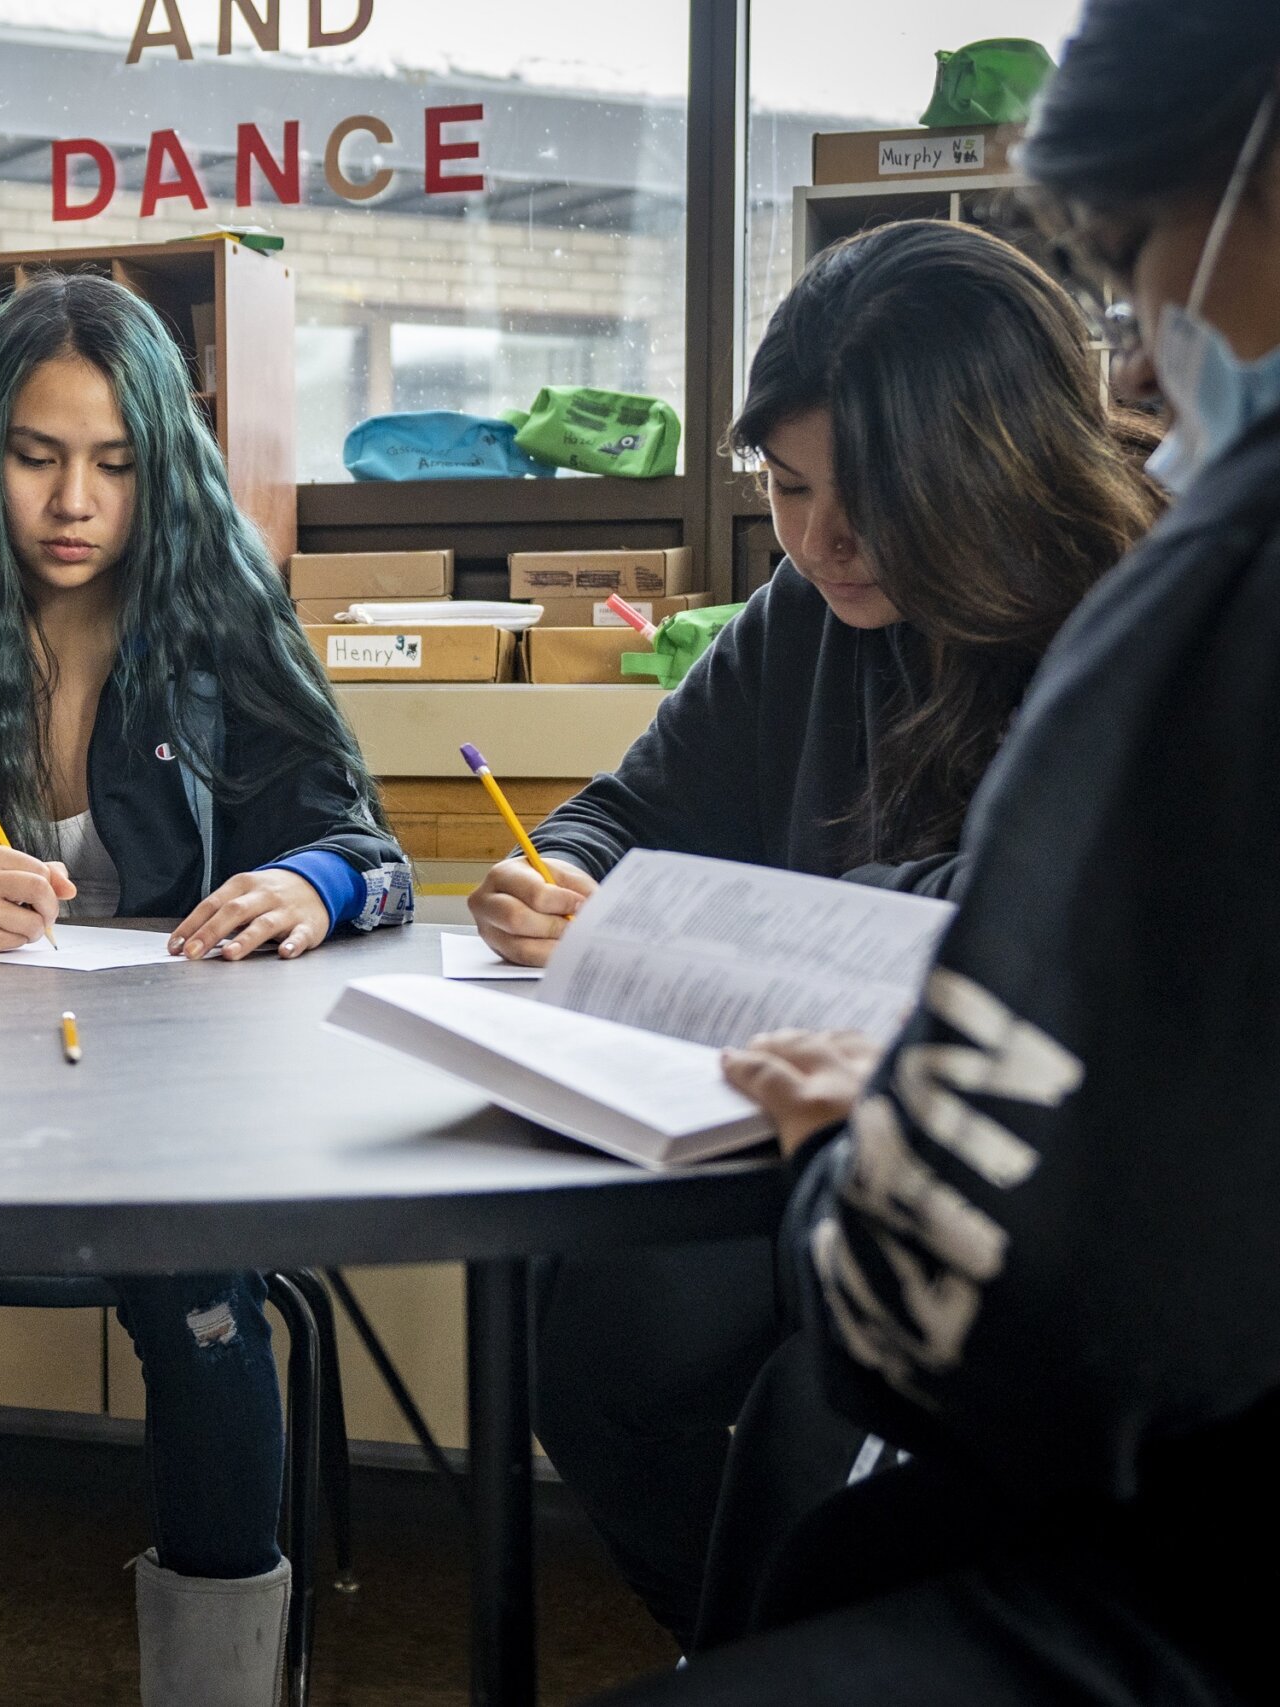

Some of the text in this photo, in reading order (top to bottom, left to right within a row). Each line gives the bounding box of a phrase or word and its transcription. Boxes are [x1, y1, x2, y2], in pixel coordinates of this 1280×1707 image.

[125, 0, 374, 65] AND
[51, 103, 484, 222] DANCE
[881, 146, 942, 170] Murphy
[335, 638, 394, 666] Henry
